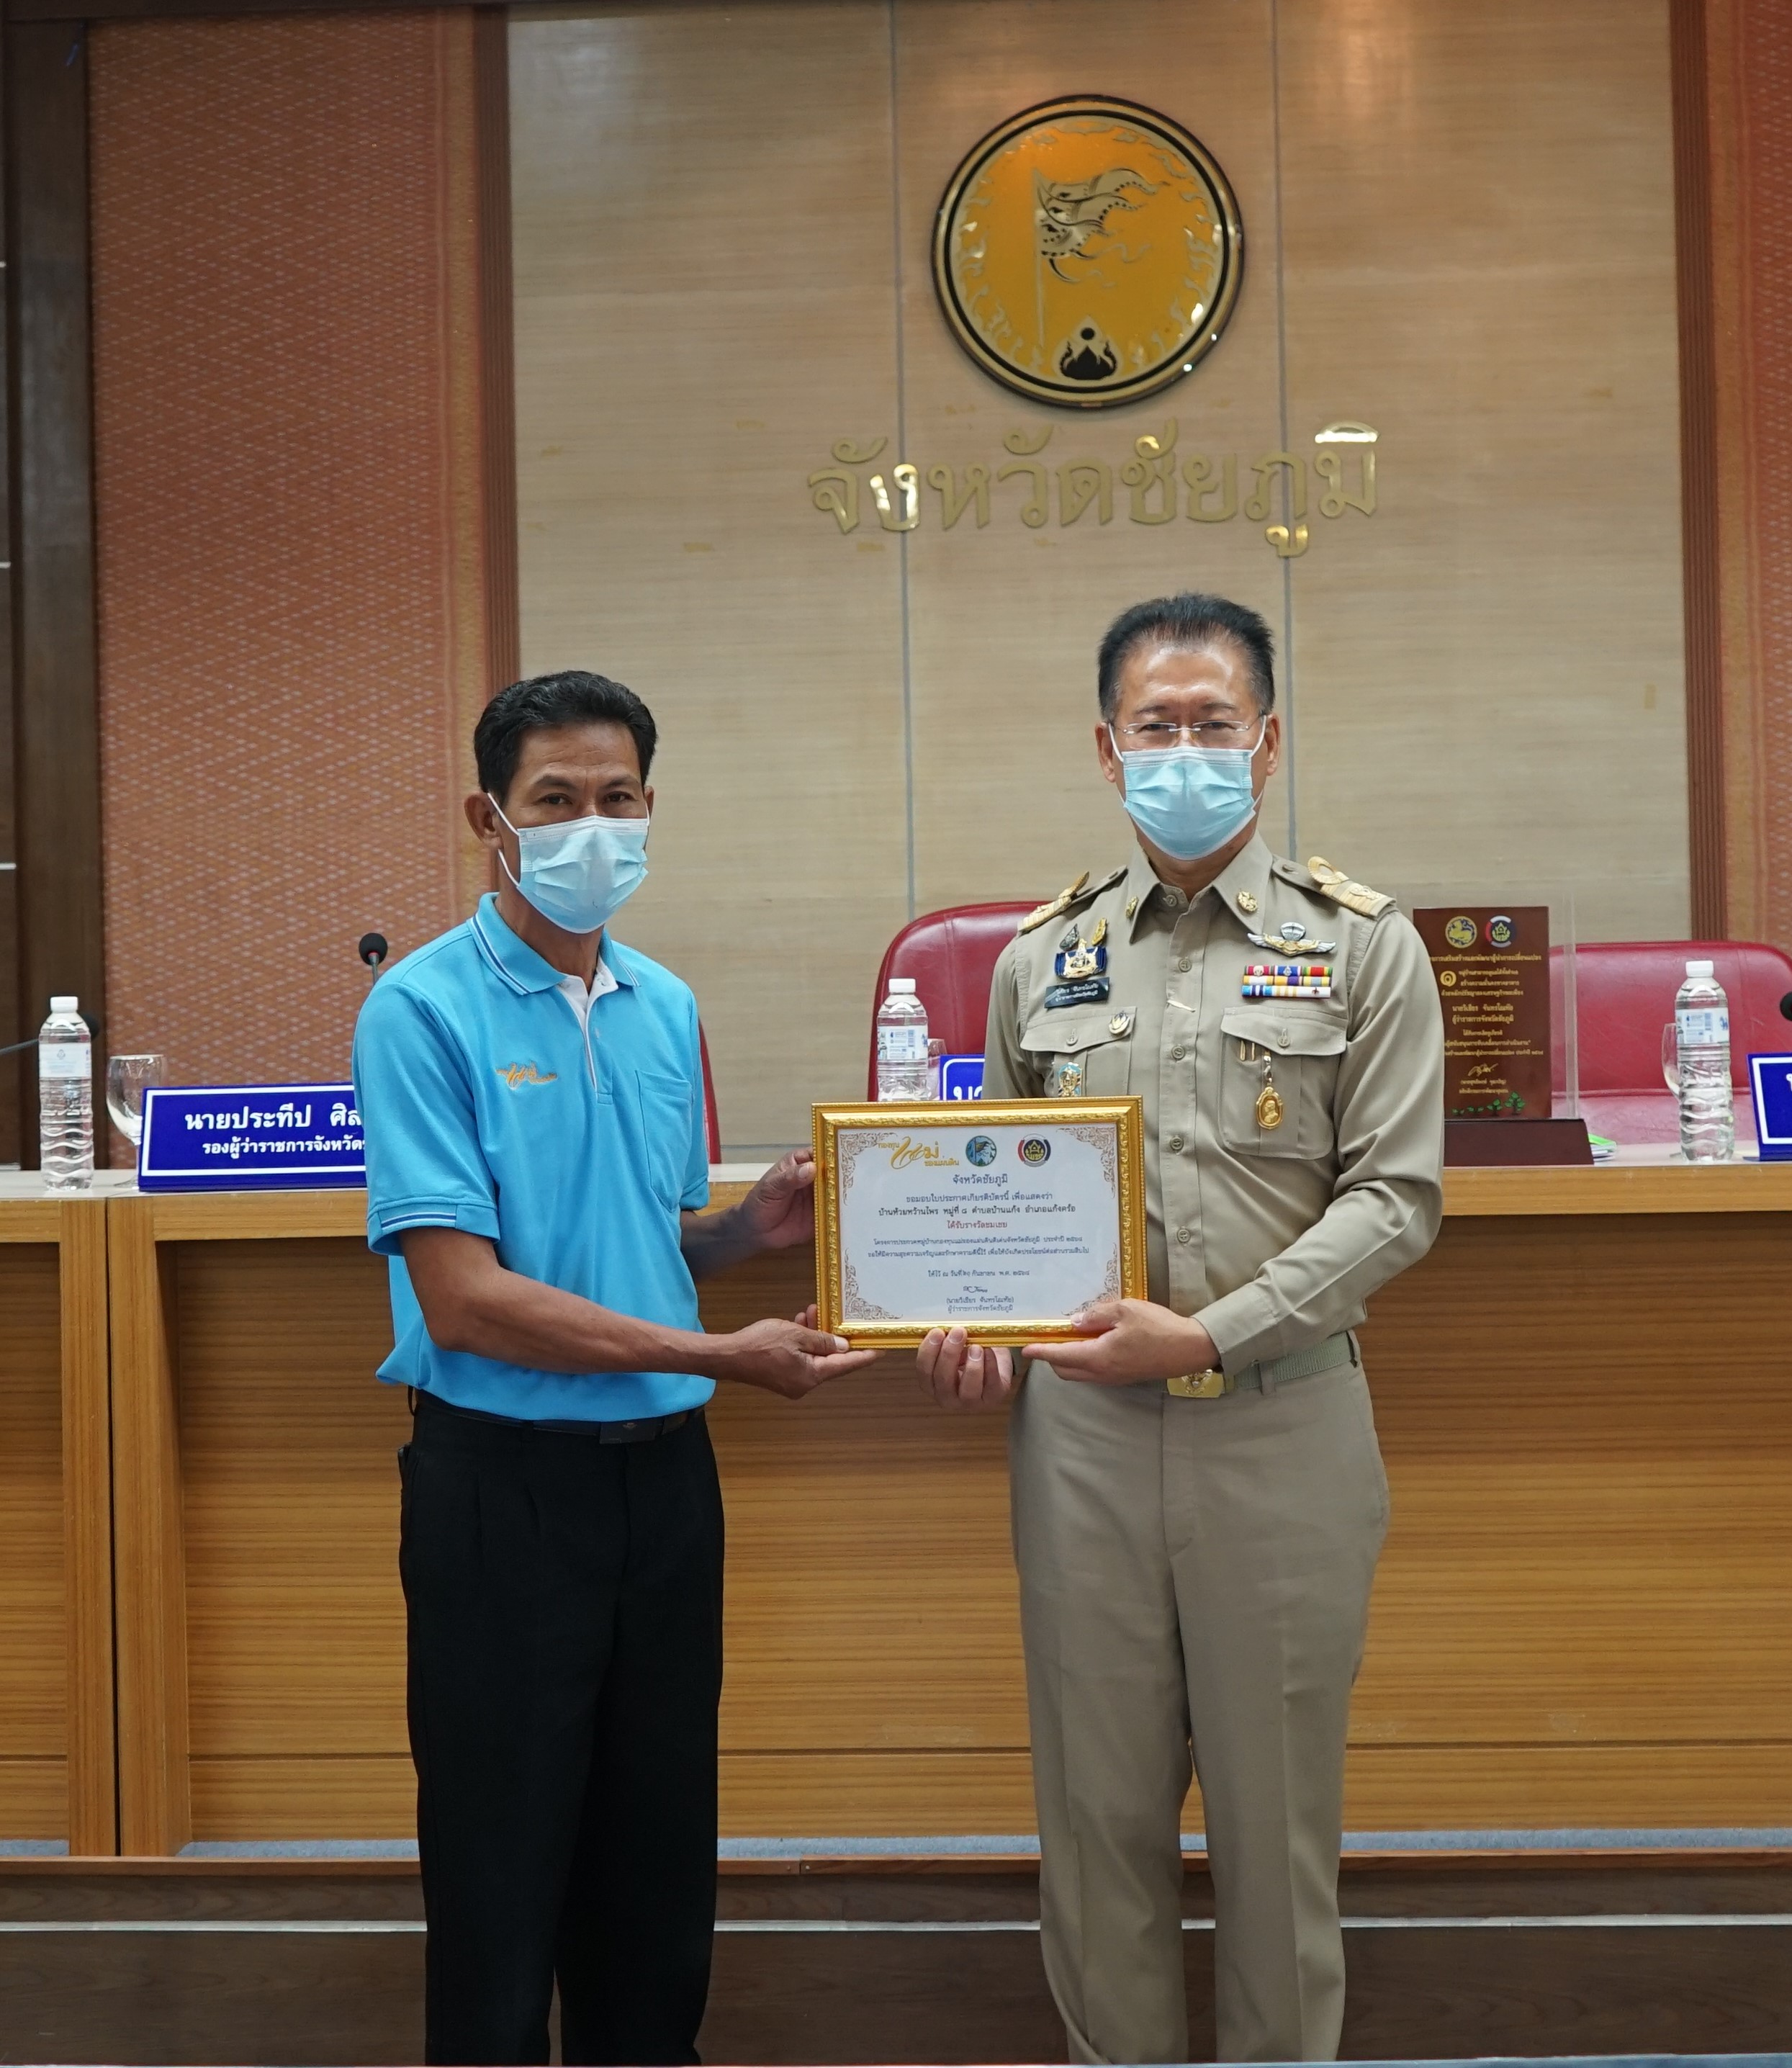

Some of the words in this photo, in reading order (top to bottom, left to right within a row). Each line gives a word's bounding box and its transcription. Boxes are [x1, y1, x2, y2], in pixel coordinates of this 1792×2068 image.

[808, 418, 1379, 557] จังหวัดชัยภูมิ
[185, 1103, 311, 1130] นายประทีป
[202, 1134, 366, 1159] รองผู้ว่าราชการจังหวัด
[953, 1174, 1008, 1187] จังหวัดชัยภูมิ
[906, 1191, 1009, 1202] ขอมอบใบประกาศเกียรติบัตรนี้
[1012, 1191, 1053, 1200] เพื่อแสดงว่า
[943, 1205, 959, 1217] หมู่ที่
[972, 1205, 1020, 1214] ตำบลบ้านแก้ง
[1025, 1204, 1076, 1213] อำเภอแก้งคร้อ
[947, 1220, 1008, 1229] ได้รับรางวัลชมเชย
